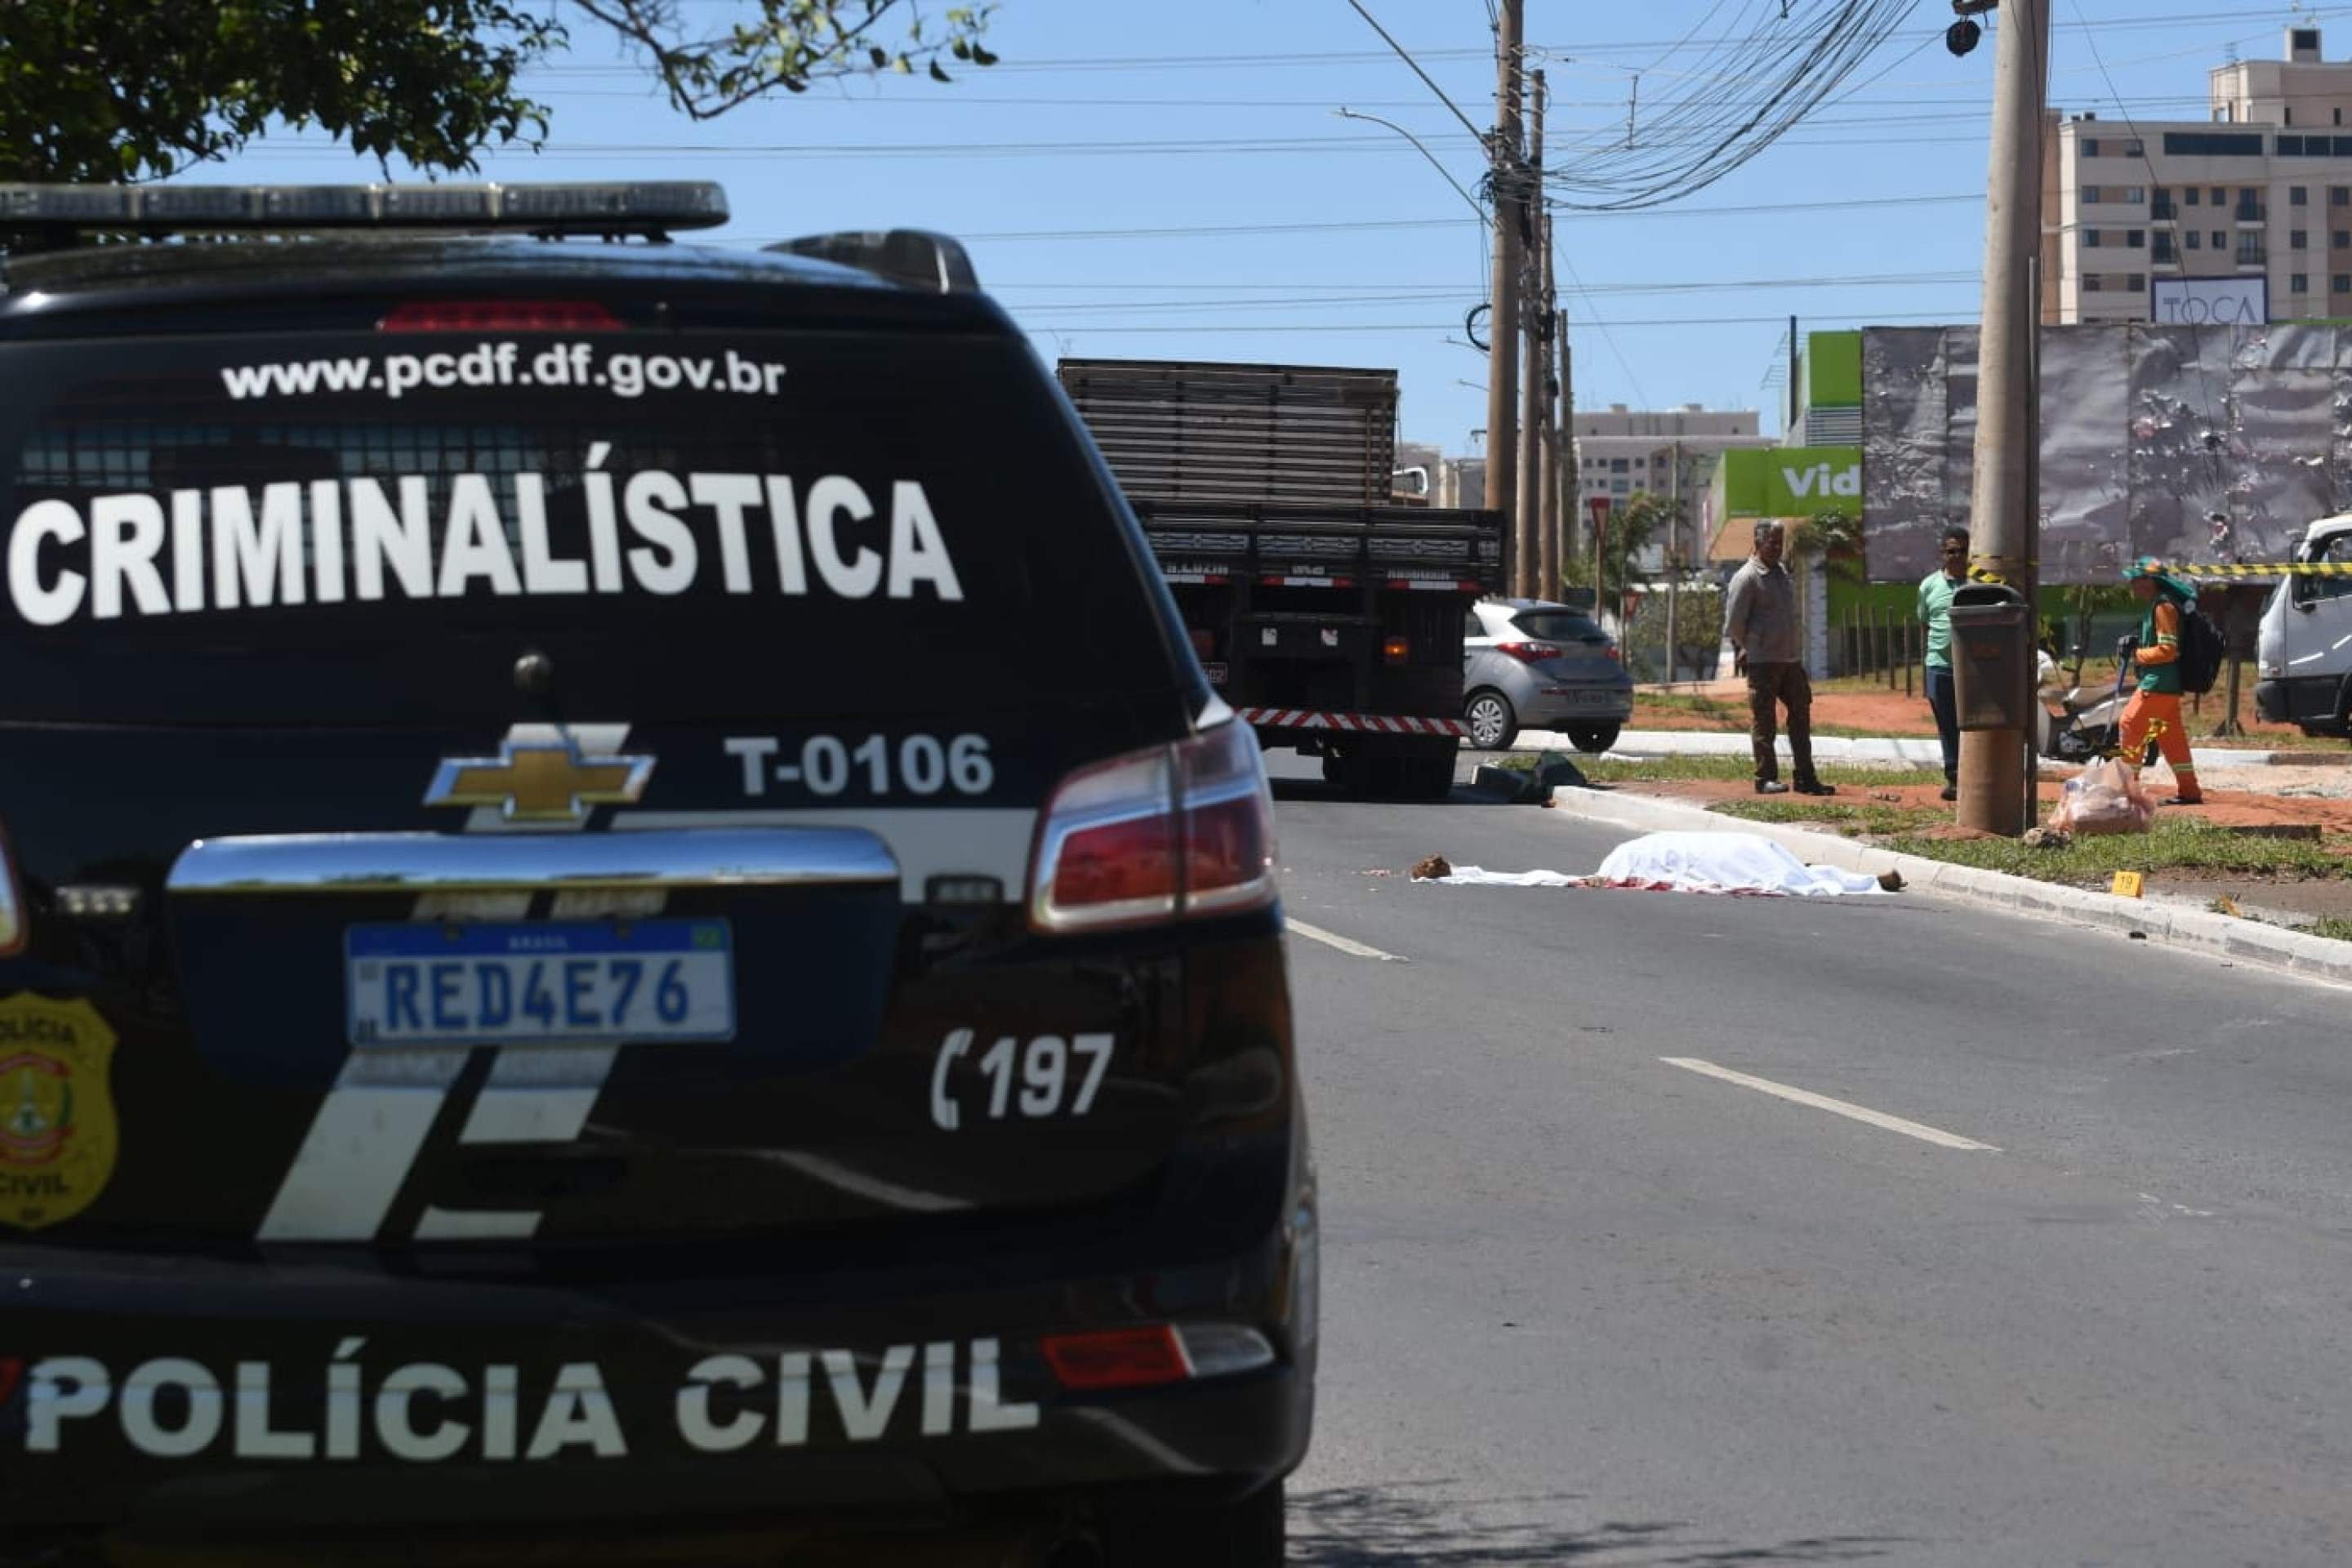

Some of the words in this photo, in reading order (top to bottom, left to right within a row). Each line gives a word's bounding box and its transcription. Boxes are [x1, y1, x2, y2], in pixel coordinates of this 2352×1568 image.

[2163, 296, 2257, 324] TOCA
[221, 343, 786, 399] www.pcdf.df.gov.br
[8, 442, 962, 626] CRIMINALÍSTICA
[724, 733, 994, 795] T-0106
[384, 959, 691, 1031] RED4E76
[979, 1033, 1115, 1118] 197
[24, 1336, 629, 1461] POLÍCIA
[675, 1337, 1040, 1452] CIVIL
